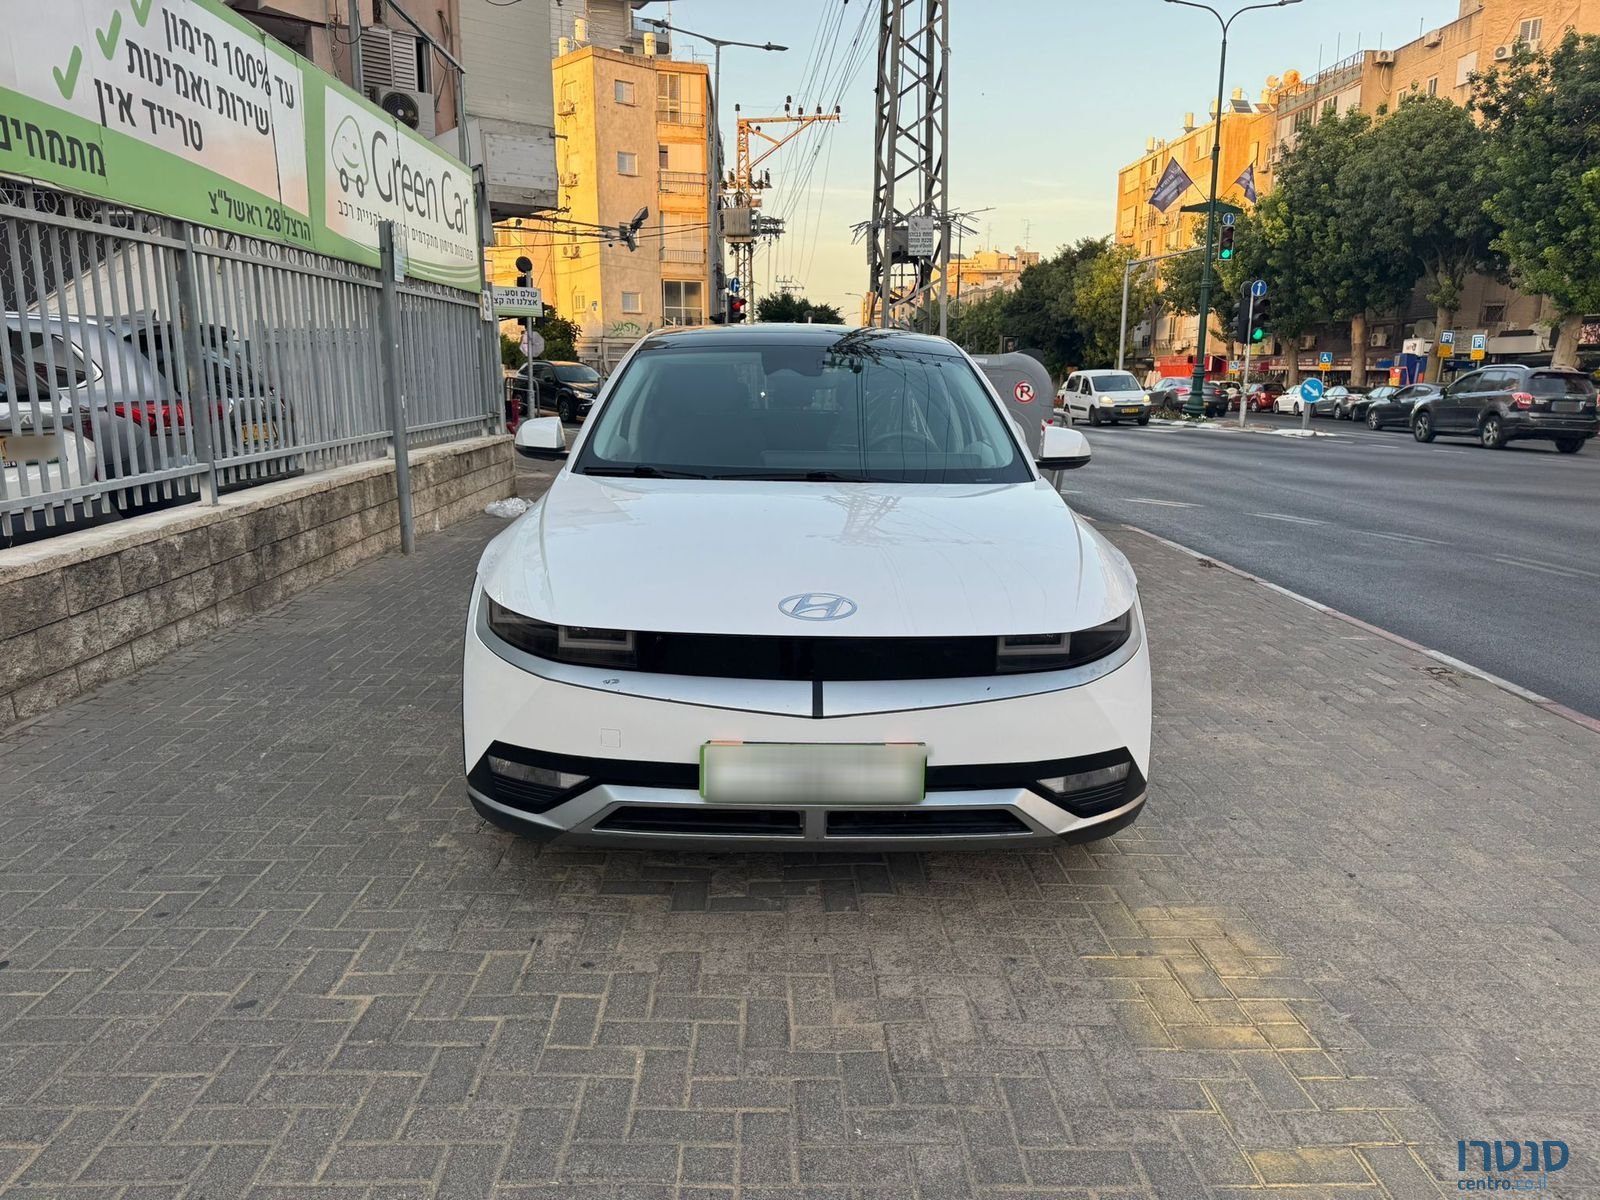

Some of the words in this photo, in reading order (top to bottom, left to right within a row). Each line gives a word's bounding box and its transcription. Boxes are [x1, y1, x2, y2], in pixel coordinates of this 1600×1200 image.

[162, 7, 218, 67] מימון
[125, 38, 212, 109] ואמינות
[223, 41, 272, 96] 100%
[94, 78, 137, 128] אין
[216, 85, 270, 135] שירות
[274, 75, 295, 109] עד
[142, 98, 203, 151] טרייד
[372, 130, 439, 223] Green
[441, 170, 469, 235] Car
[208, 188, 263, 227] ראשל"צ
[265, 206, 281, 232] 28
[283, 210, 311, 241] הרצל
[338, 199, 354, 219] רכב
[517, 298, 538, 306] אצלנו
[520, 289, 538, 298] שלם
